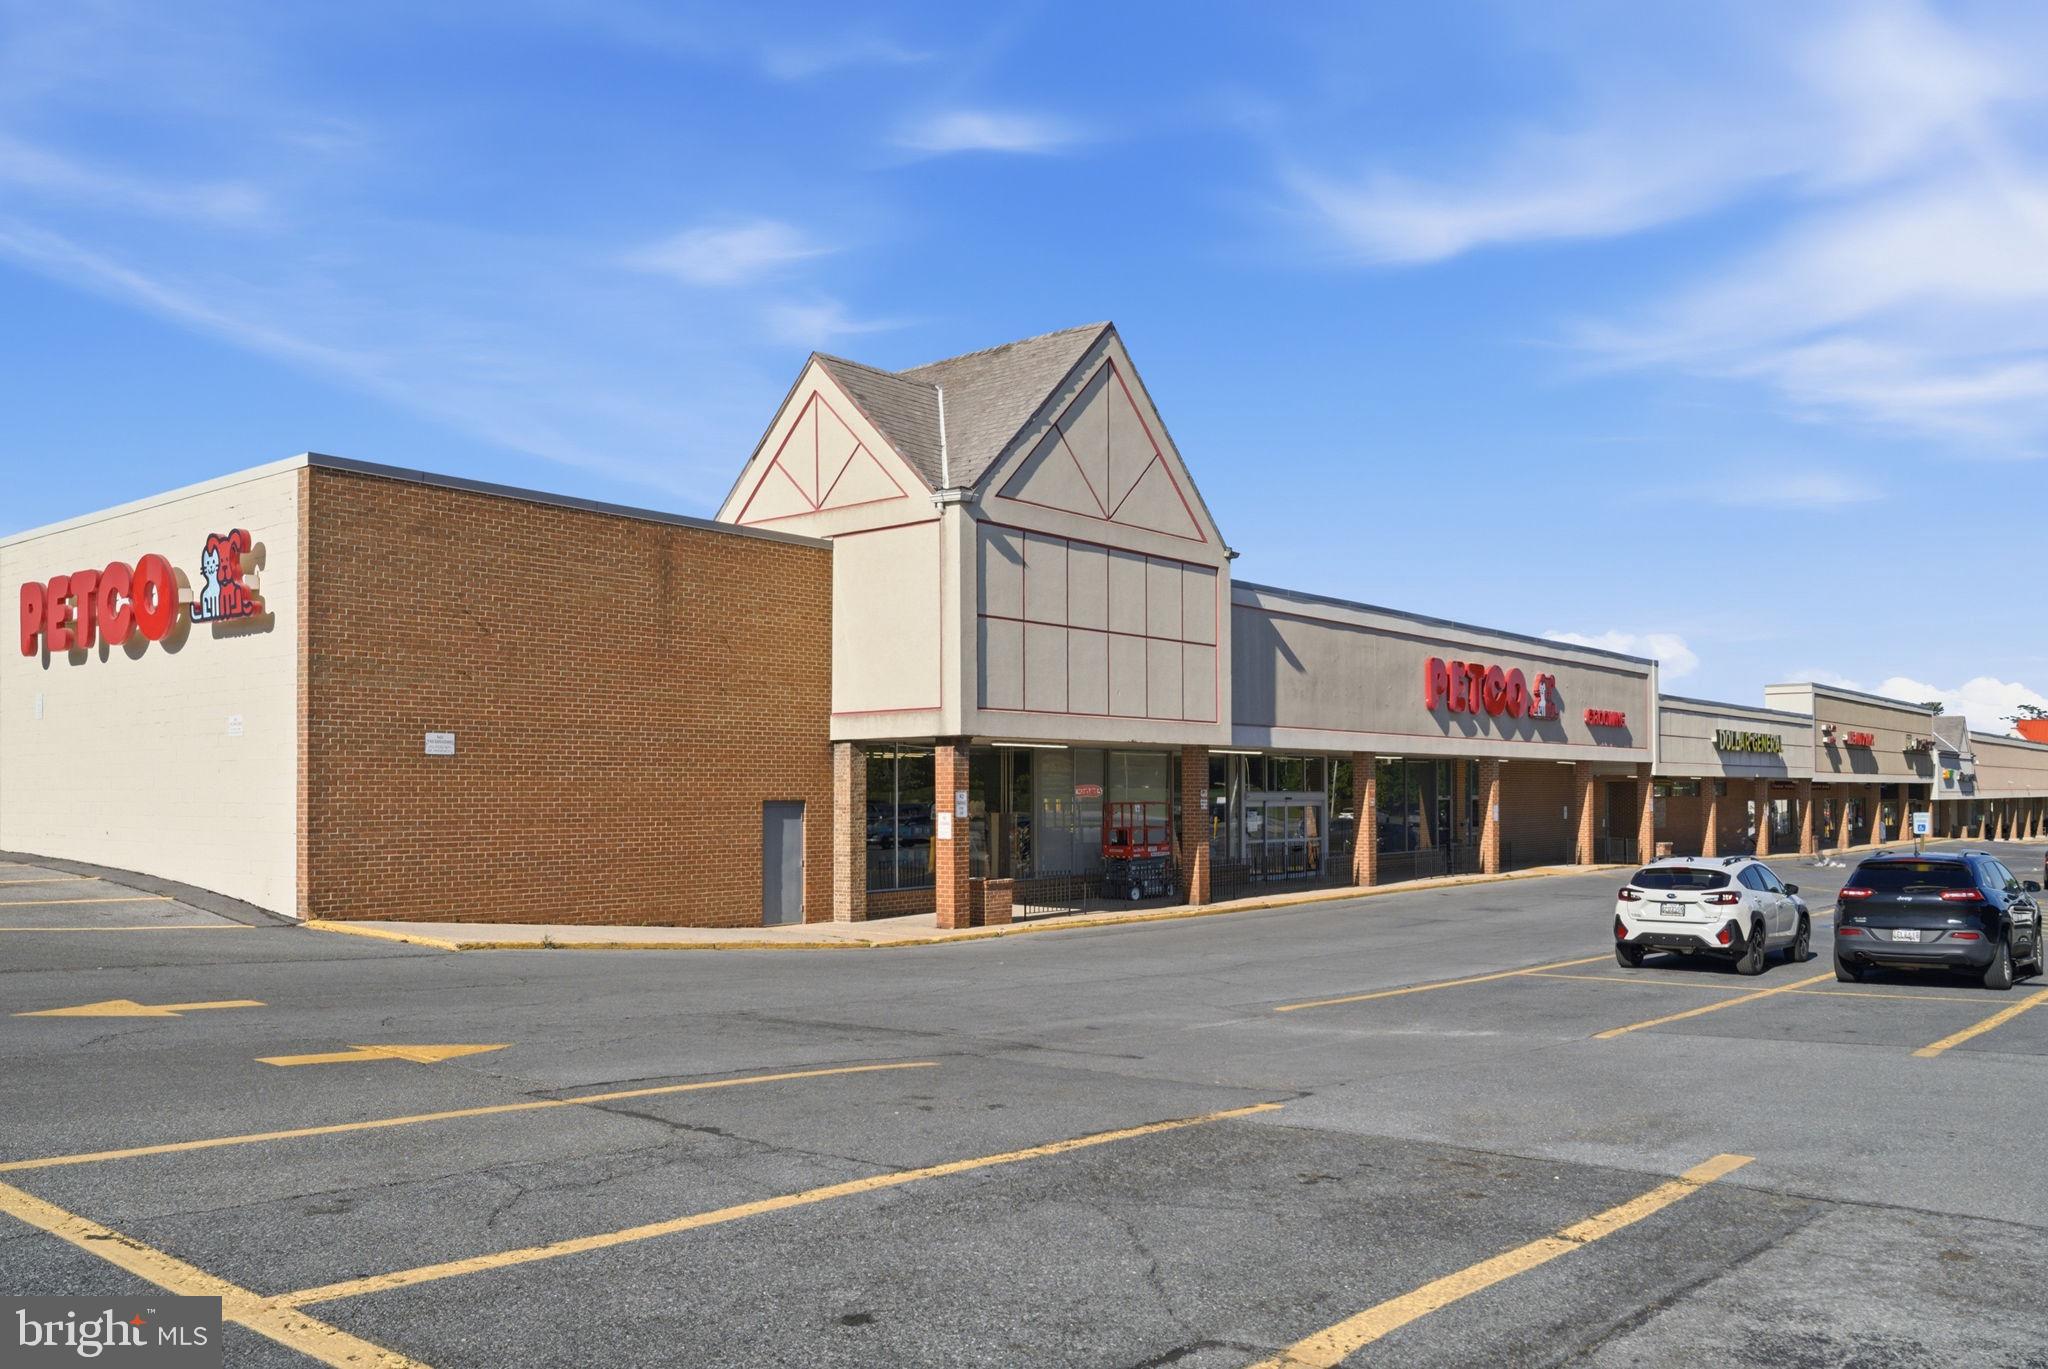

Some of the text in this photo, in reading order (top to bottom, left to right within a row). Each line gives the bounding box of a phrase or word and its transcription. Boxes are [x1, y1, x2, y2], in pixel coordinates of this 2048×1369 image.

[20, 553, 180, 657] PETCO
[1424, 656, 1528, 718] PETCO
[1584, 707, 1627, 728] GROOMING
[1716, 729, 1784, 754] DOLLAR GENERAL
